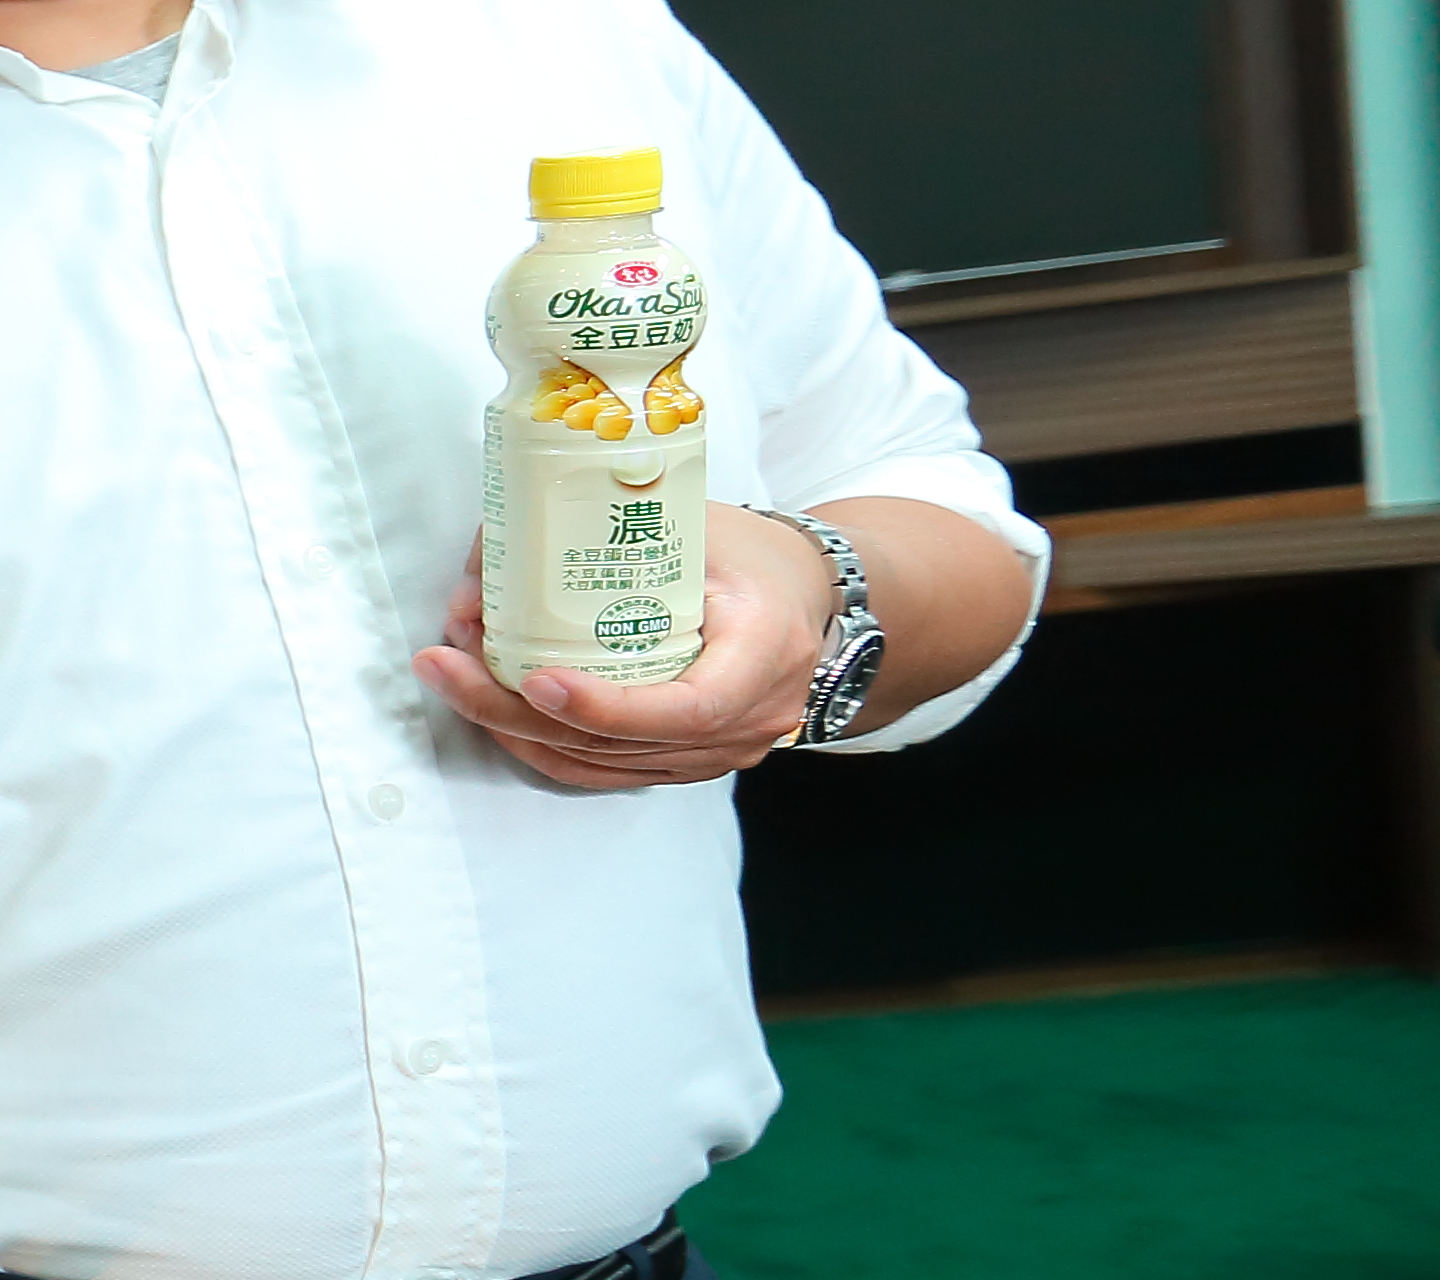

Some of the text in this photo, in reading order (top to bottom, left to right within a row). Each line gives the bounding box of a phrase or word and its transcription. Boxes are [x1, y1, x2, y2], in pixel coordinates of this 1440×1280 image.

[570, 317, 694, 351] 全豆豆奶
[597, 616, 671, 637] NON GMO
